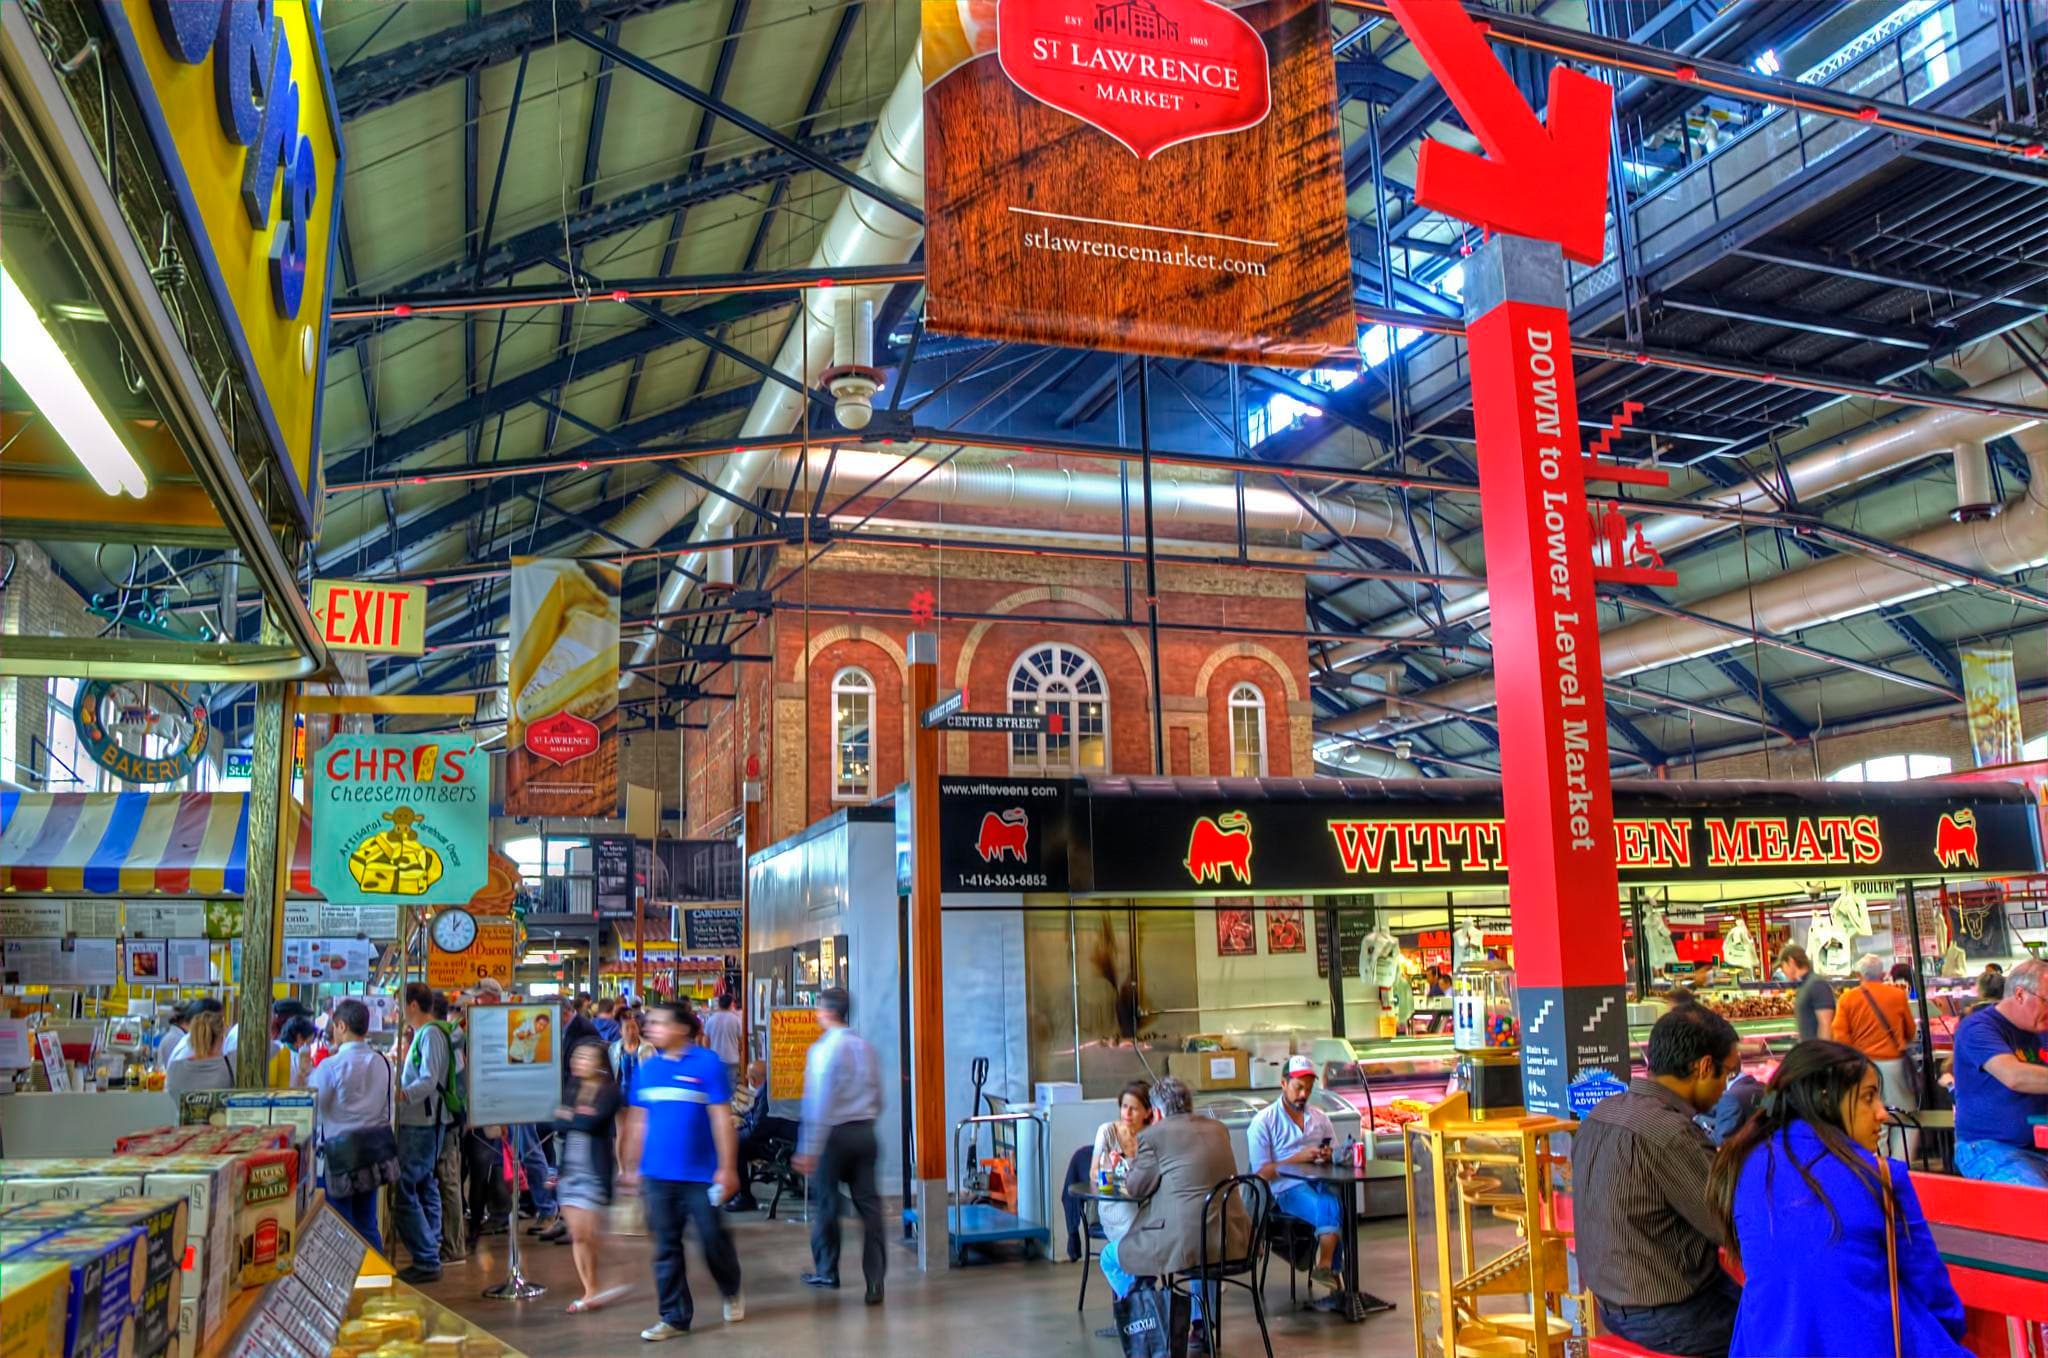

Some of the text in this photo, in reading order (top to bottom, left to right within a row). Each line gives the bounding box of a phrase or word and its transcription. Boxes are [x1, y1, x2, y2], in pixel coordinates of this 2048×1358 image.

[1065, 15, 1083, 26] EST
[1071, 43, 1240, 91] LAWRENCE
[1096, 83, 1184, 111] MARKET
[1024, 228, 1268, 277] stlawrencemarket.com
[1527, 327, 1595, 850] DOWN to Lower Level Market
[325, 587, 410, 647] EXIT
[929, 693, 962, 722] MARKET STREET
[947, 715, 1040, 729] CENTRE STREET
[544, 736, 591, 745] LAWRENCE
[102, 744, 182, 781] BAKERY
[331, 784, 477, 803] Cheesemongers
[1704, 815, 1883, 867] MEATS
[959, 874, 1048, 887] 1-416-363-6852
[1853, 880, 1896, 894] POULTRY
[1676, 908, 1697, 919] PORK
[1526, 1045, 1541, 1054] Stairs
[1578, 1045, 1608, 1055] Stairs to:
[1526, 1055, 1558, 1067] Lower Level
[1578, 1054, 1619, 1065] Lower Level
[1527, 1066, 1546, 1076] Market
[246, 1183, 289, 1201] CRACKERS
